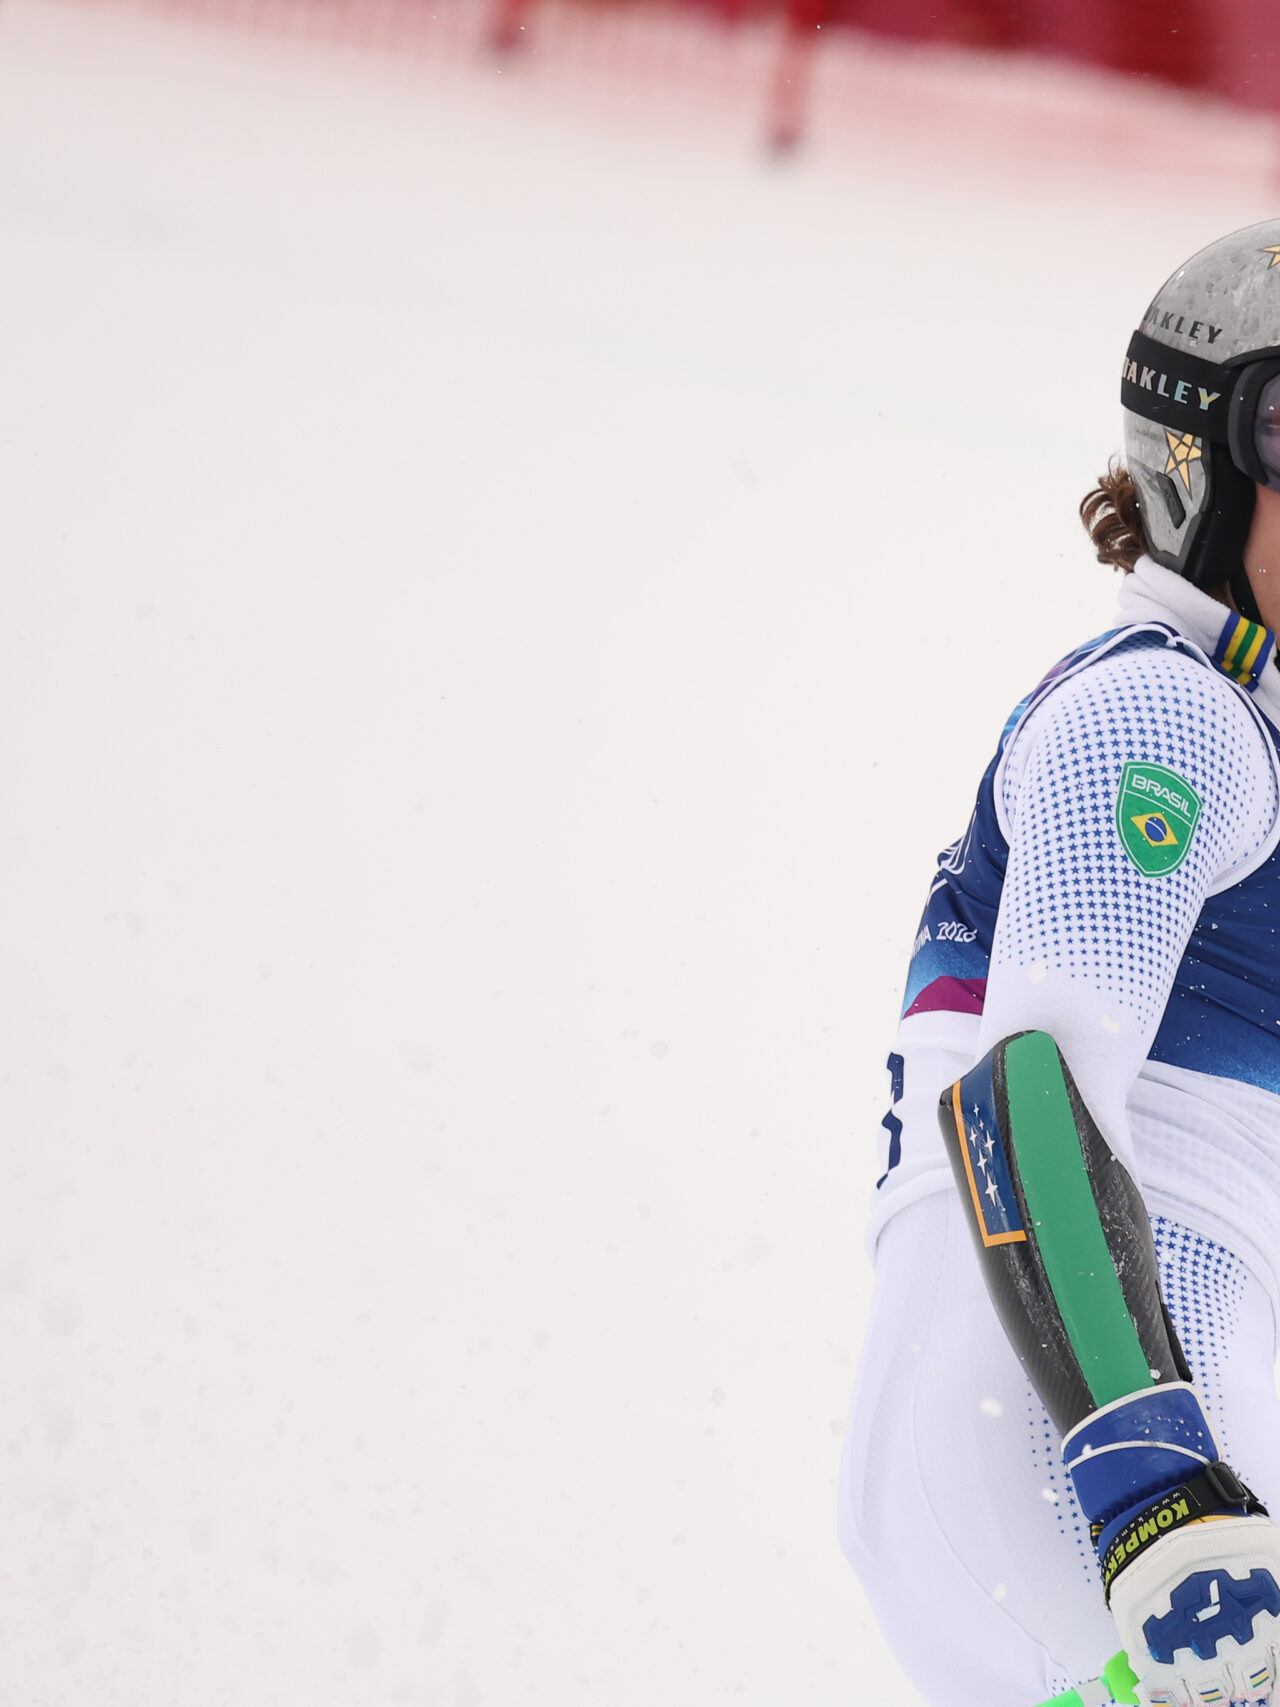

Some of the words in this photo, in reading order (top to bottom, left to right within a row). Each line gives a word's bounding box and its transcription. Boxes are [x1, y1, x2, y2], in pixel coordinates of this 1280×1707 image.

[1146, 306, 1223, 344] AKLEY
[1131, 774, 1192, 818] BRASIL
[935, 920, 978, 943] 2026
